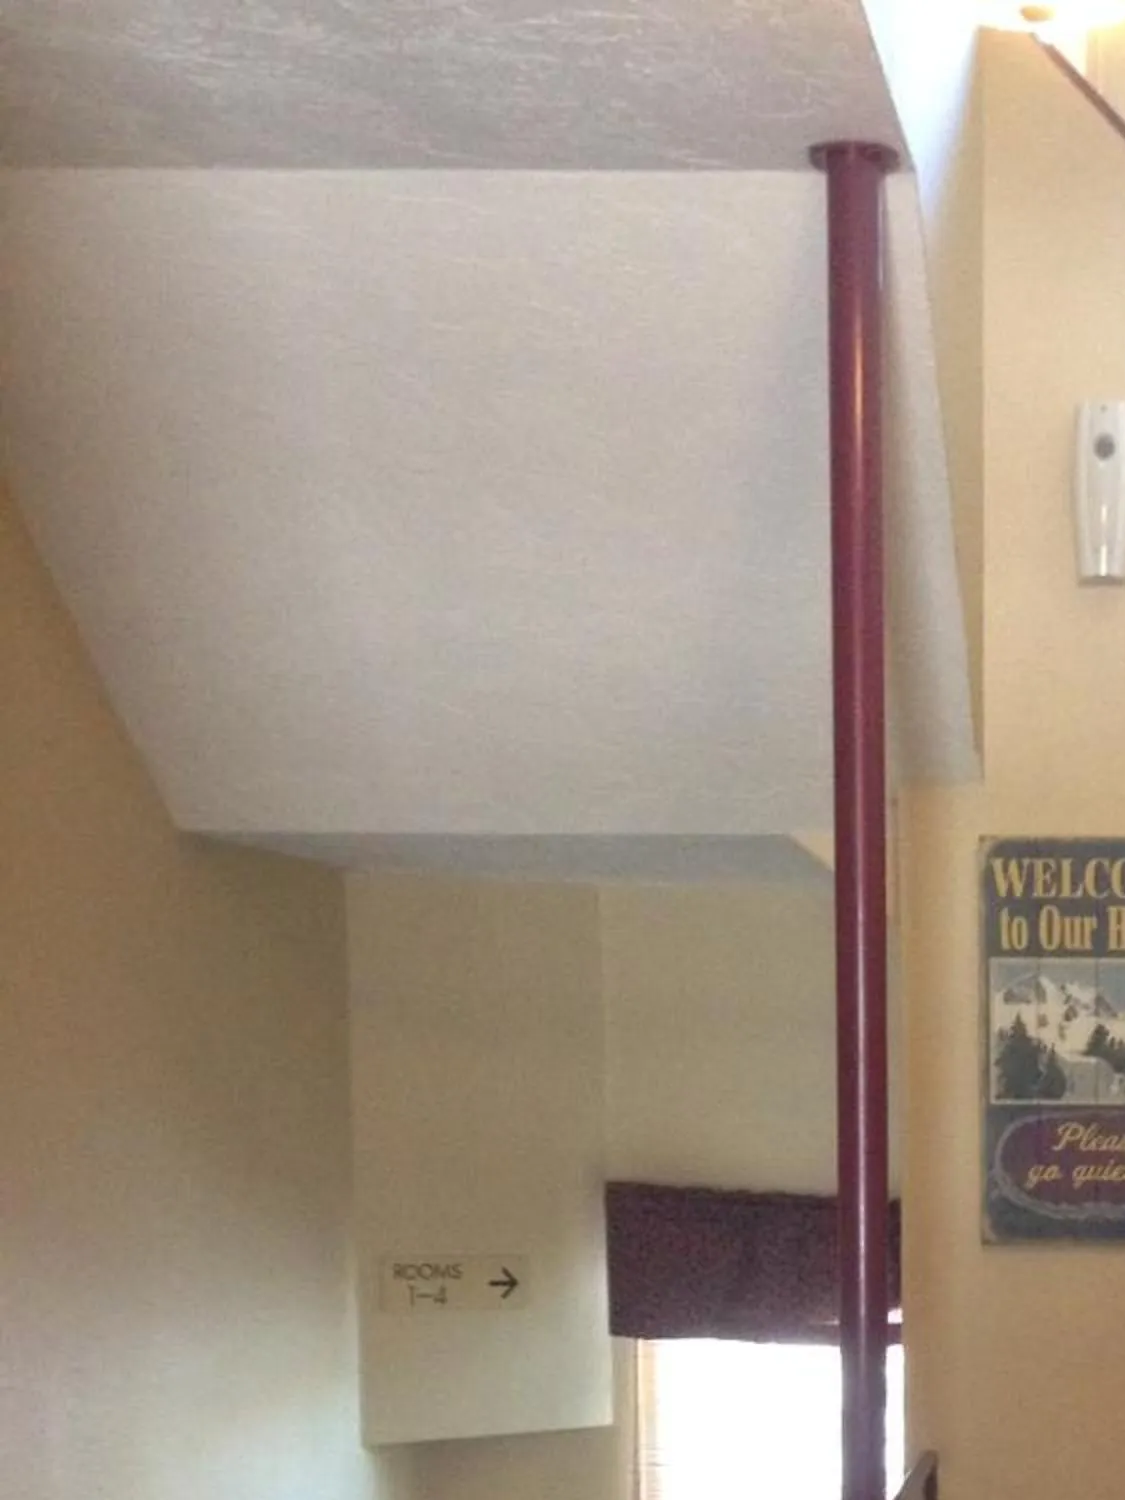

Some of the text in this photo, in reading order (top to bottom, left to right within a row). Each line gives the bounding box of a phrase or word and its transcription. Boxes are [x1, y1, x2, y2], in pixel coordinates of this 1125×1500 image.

[1000, 908, 1028, 951] to
[1038, 905, 1098, 951] Our
[1027, 1164, 1062, 1190] go
[392, 1262, 463, 1281] ROOMS
